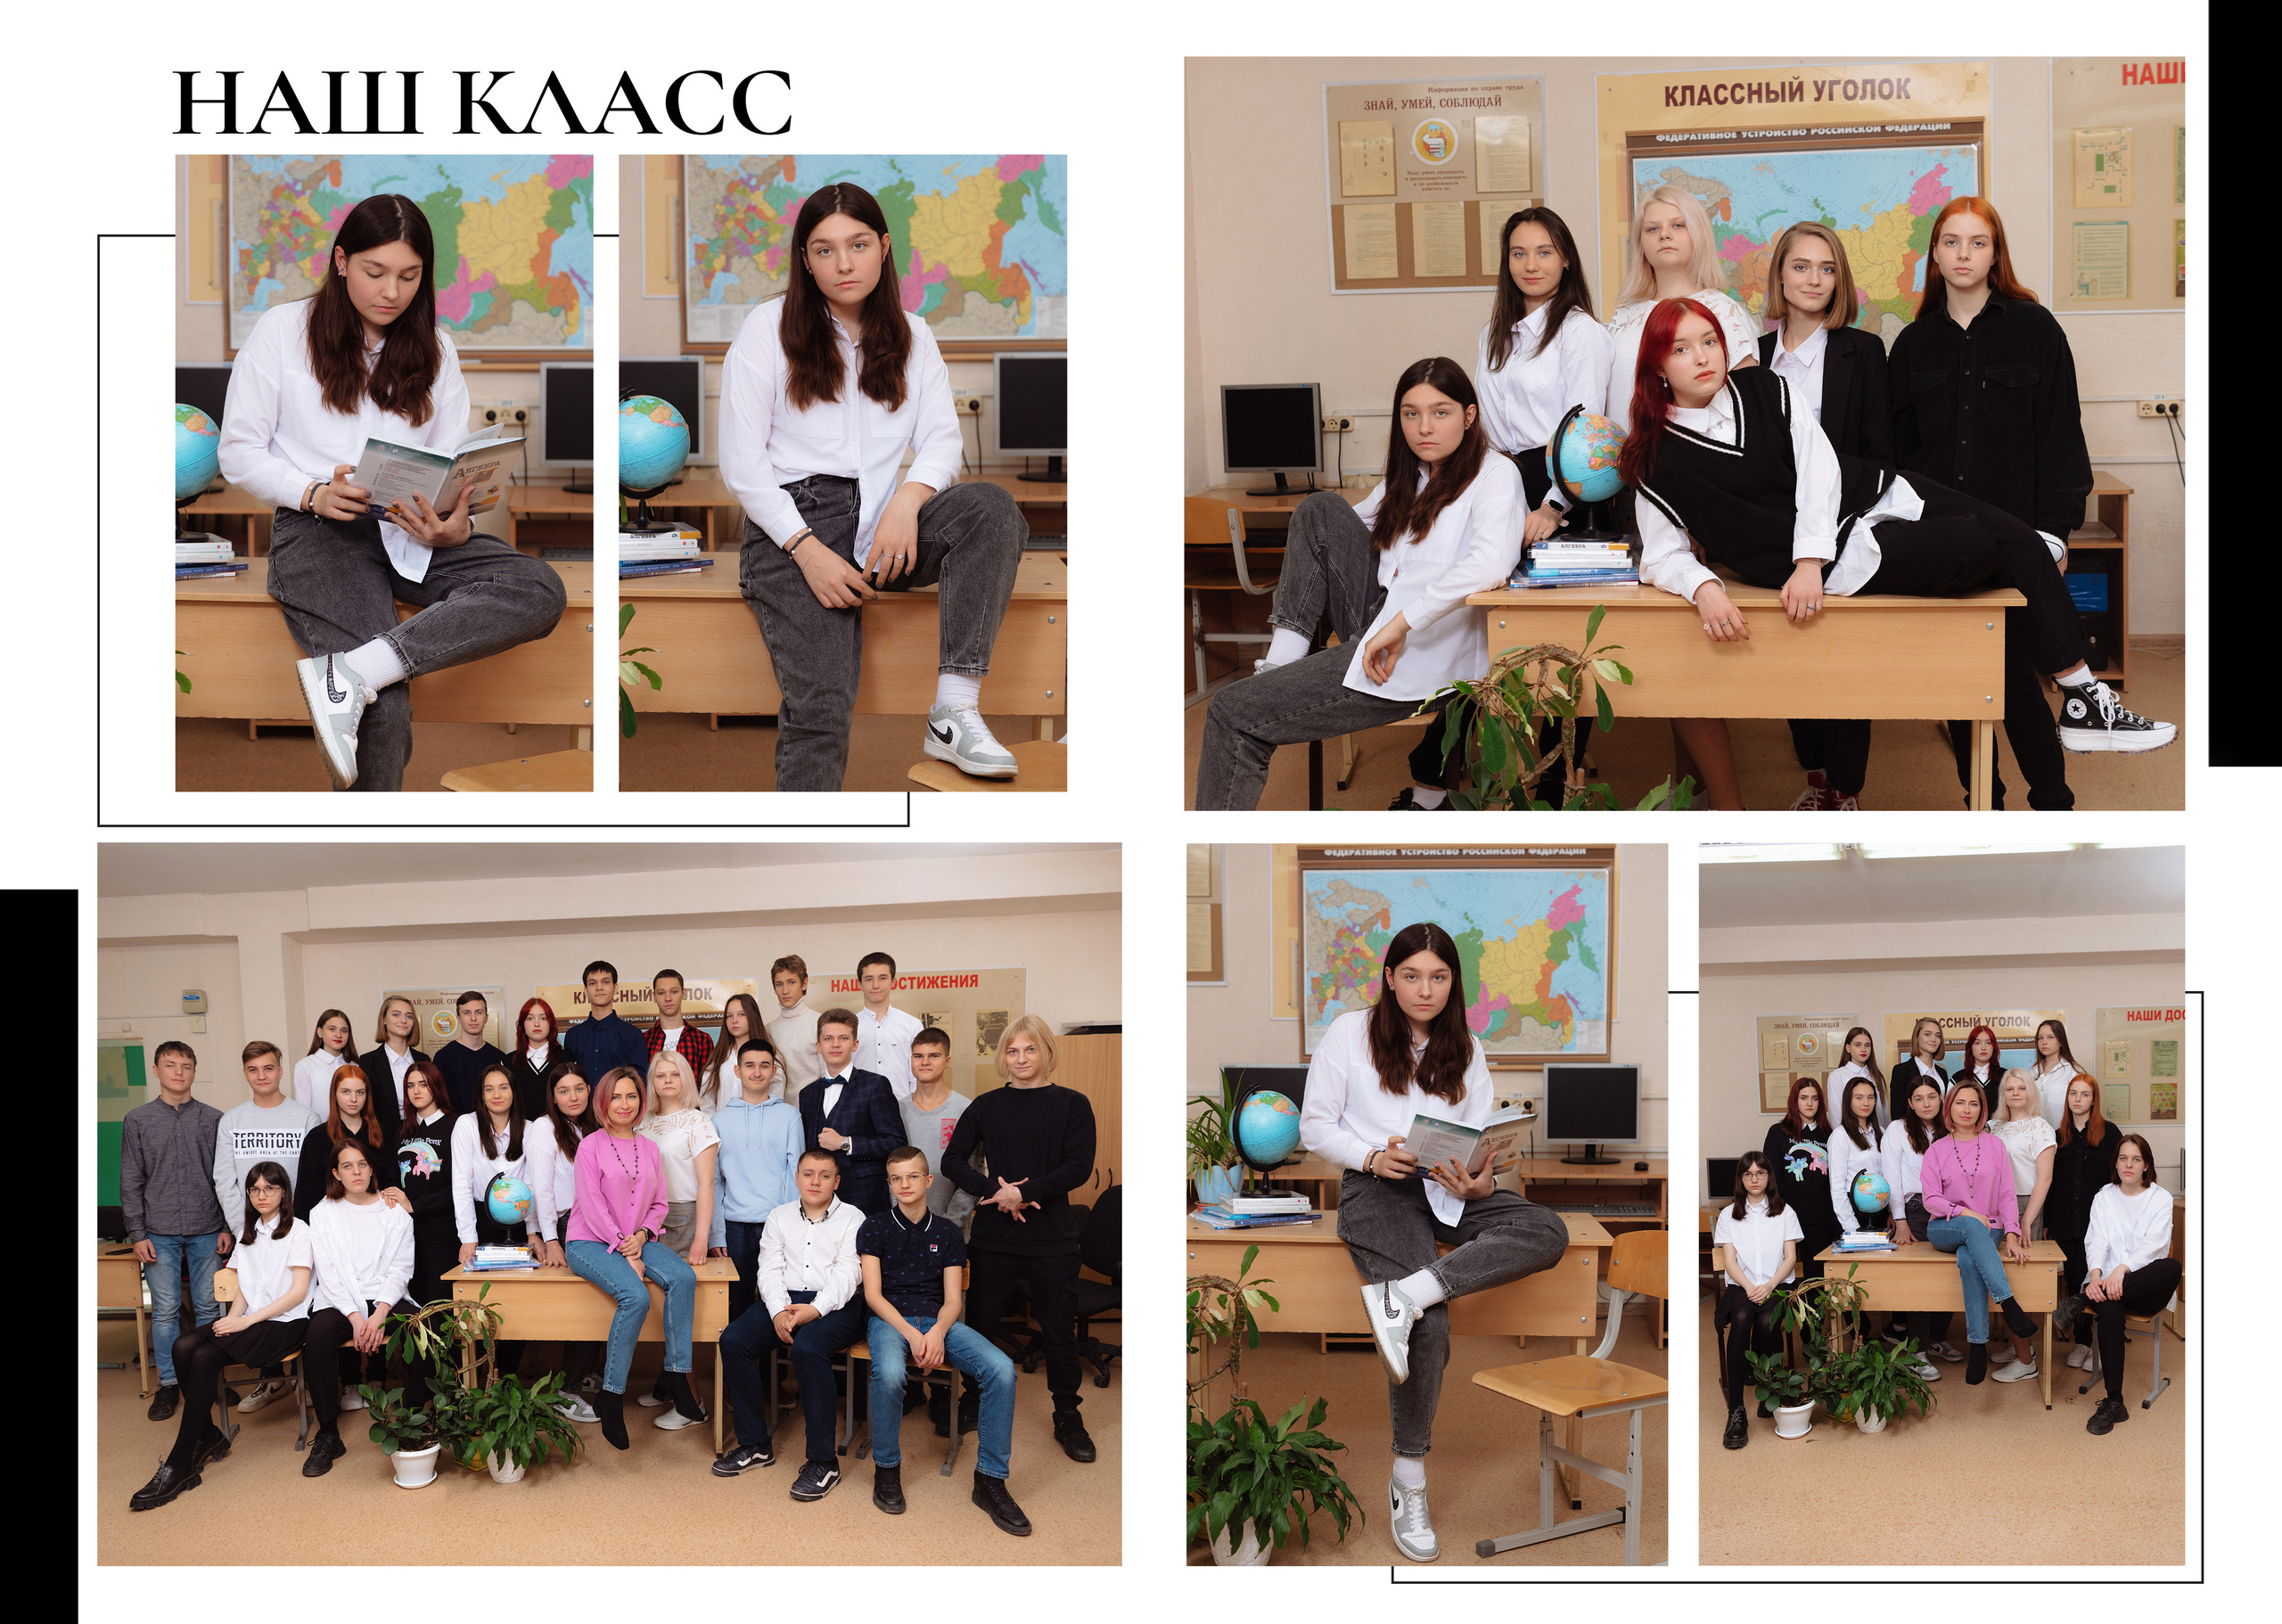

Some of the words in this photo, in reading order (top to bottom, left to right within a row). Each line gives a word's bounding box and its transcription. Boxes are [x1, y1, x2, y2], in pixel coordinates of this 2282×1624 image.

[1664, 76, 1804, 108] КЛАССНЫЙ
[1812, 77, 1911, 103] УГОЛОК
[1364, 98, 1398, 111] ЗНАЙ,
[1401, 95, 1436, 110] УМЕЙ,
[1440, 94, 1502, 109] СОБЛЮДАЙ
[1655, 132, 1737, 143] ФЕДЕРАТИВНОЕ
[1884, 123, 1951, 132] ФЕДЕРАЦИИ
[1324, 849, 1398, 857] ФЕДЕРАТИВНОЕ
[1528, 848, 1587, 856] ФЕДЕРАЦИИ
[831, 979, 863, 993] НАШ
[890, 974, 979, 991] ОСТИЖЕНИЯ
[1985, 1016, 2031, 1028] УГОЛОК
[2127, 1010, 2162, 1021] НАШИ
[234, 1132, 301, 1149] TERRITORY
